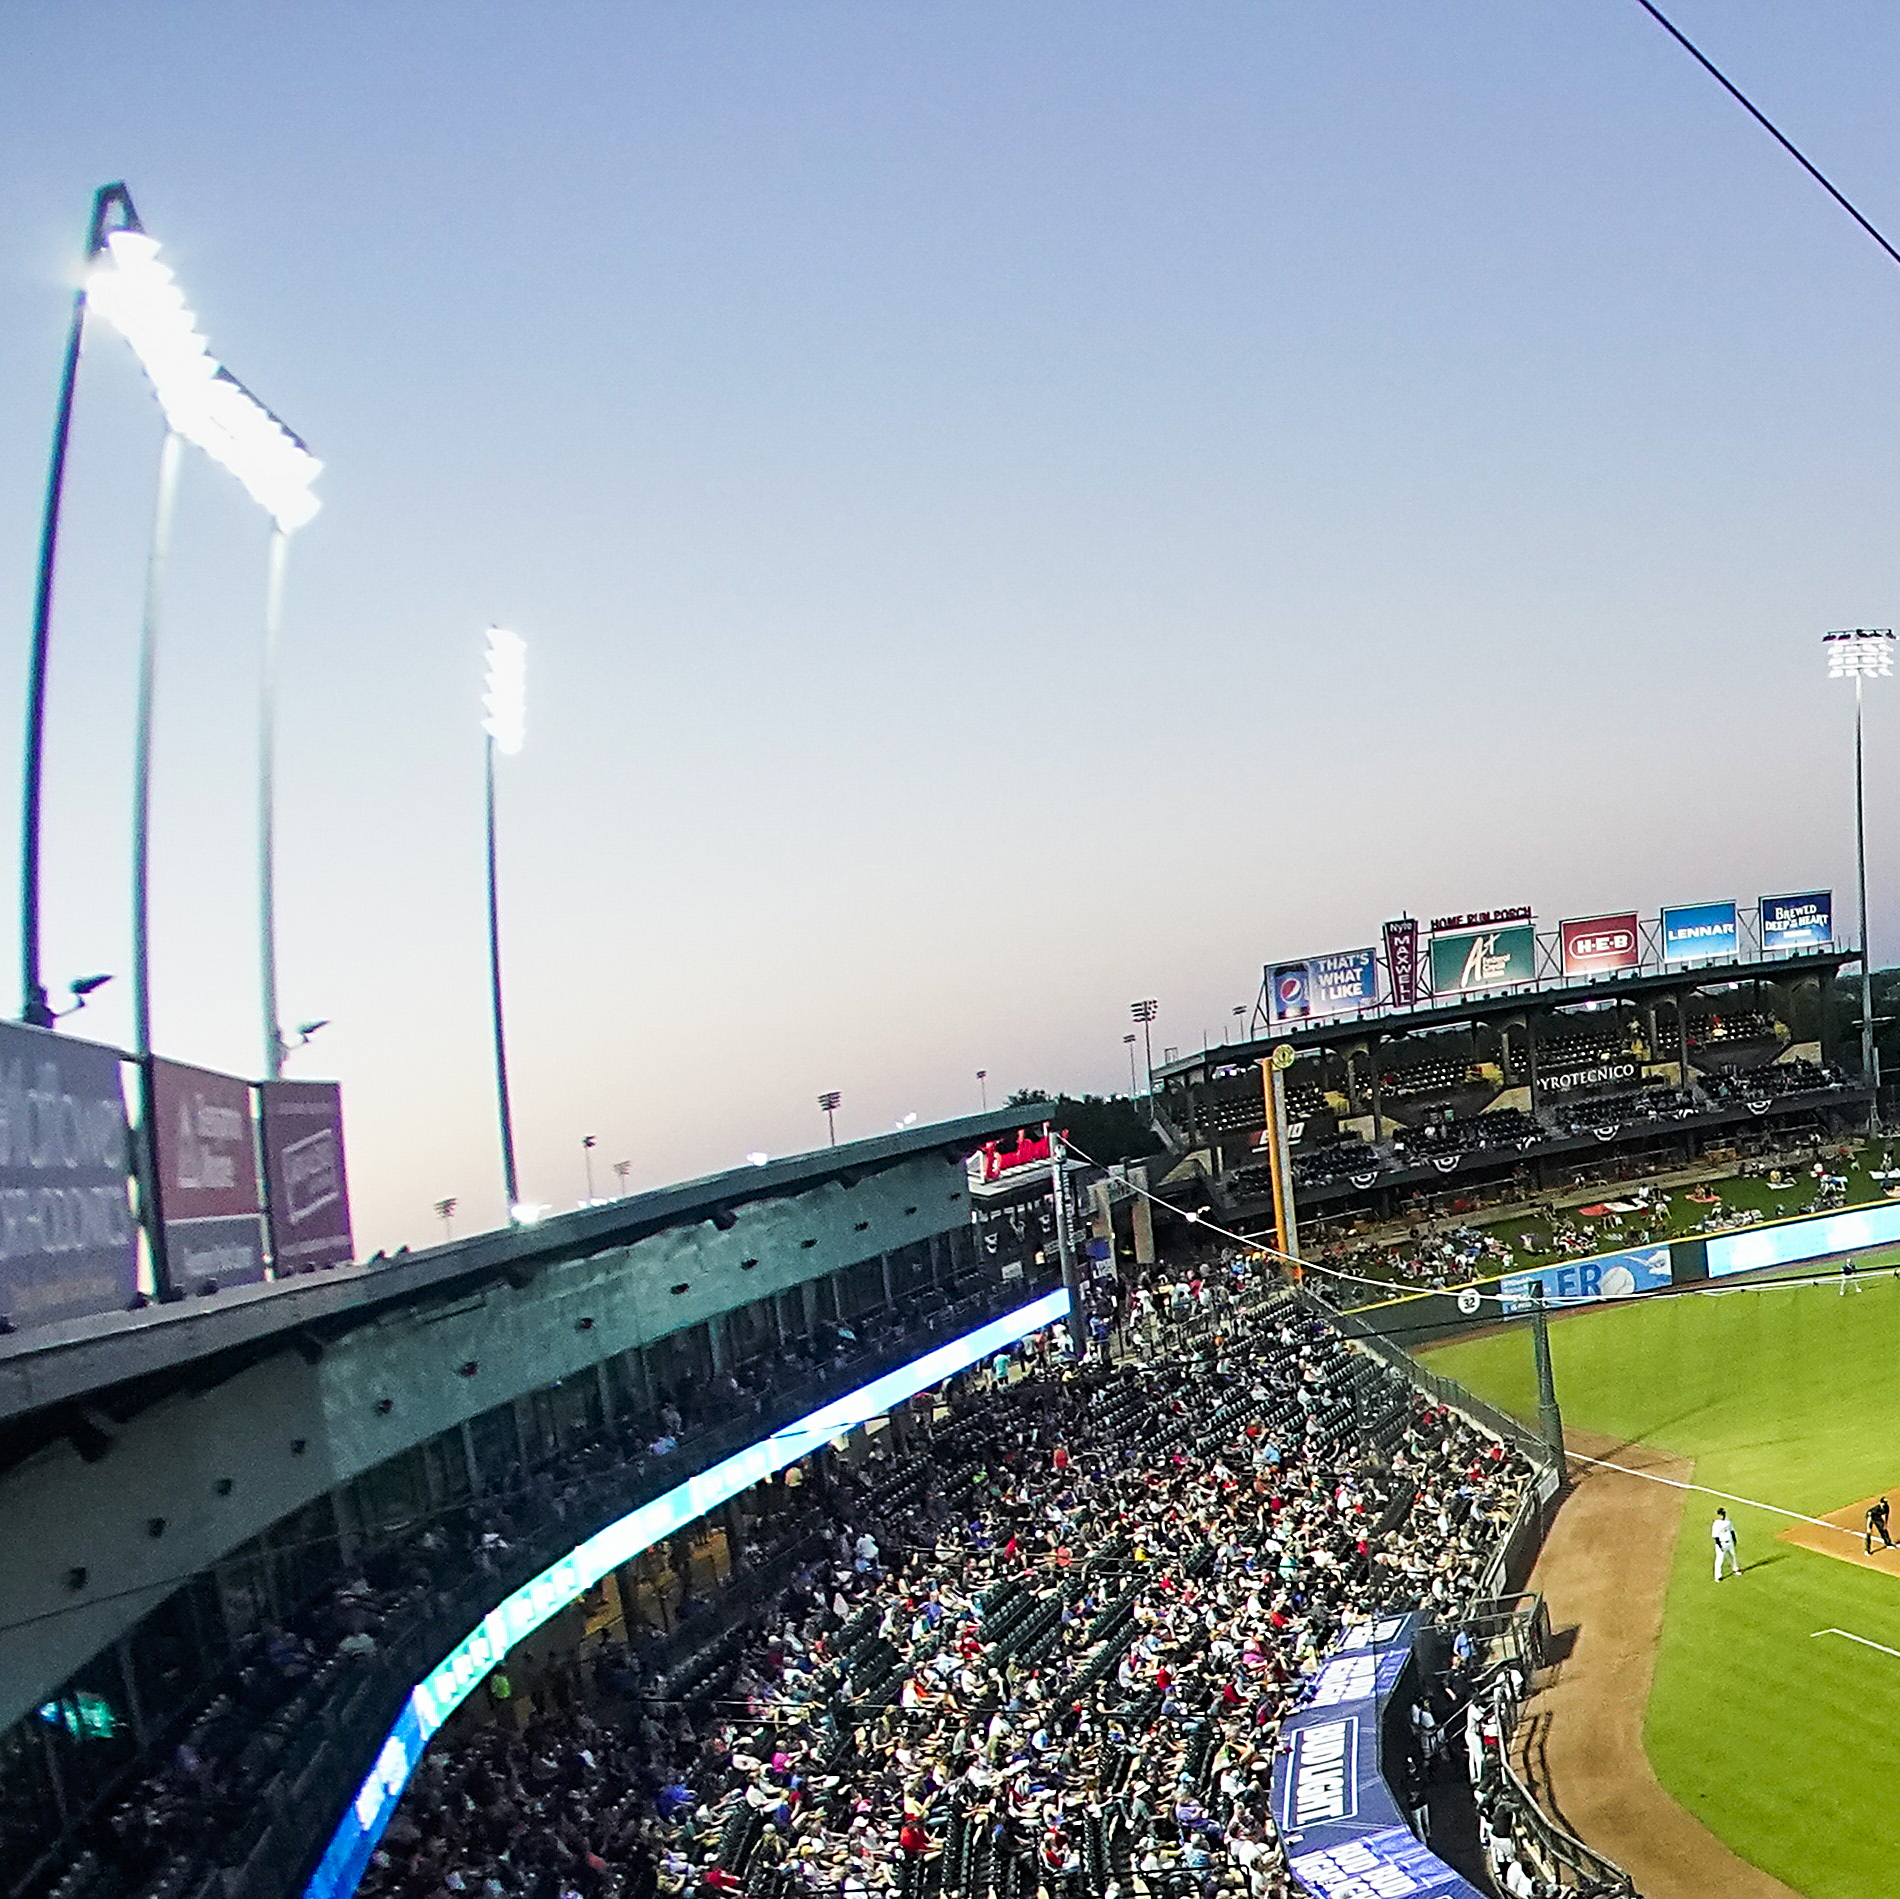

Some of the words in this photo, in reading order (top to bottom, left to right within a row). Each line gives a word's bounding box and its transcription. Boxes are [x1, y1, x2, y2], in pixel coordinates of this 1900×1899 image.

[1431, 915, 1464, 930] HOME
[1494, 905, 1532, 921] PORCH
[1775, 904, 1817, 921] BREWED
[1390, 922, 1413, 934] Nyle
[1668, 923, 1735, 941] LENNAR
[1765, 919, 1790, 931] DEEP
[1798, 914, 1829, 927] HEART
[1318, 952, 1370, 972] THAT'S
[1393, 935, 1413, 1003] MAXWELL
[1319, 968, 1363, 987] WHAT
[1330, 983, 1363, 1000] LIKE
[1537, 1063, 1635, 1092] YROTECNICO
[1300, 1721, 1347, 1766] BUD
[1296, 1758, 1345, 1826] LIGHT
